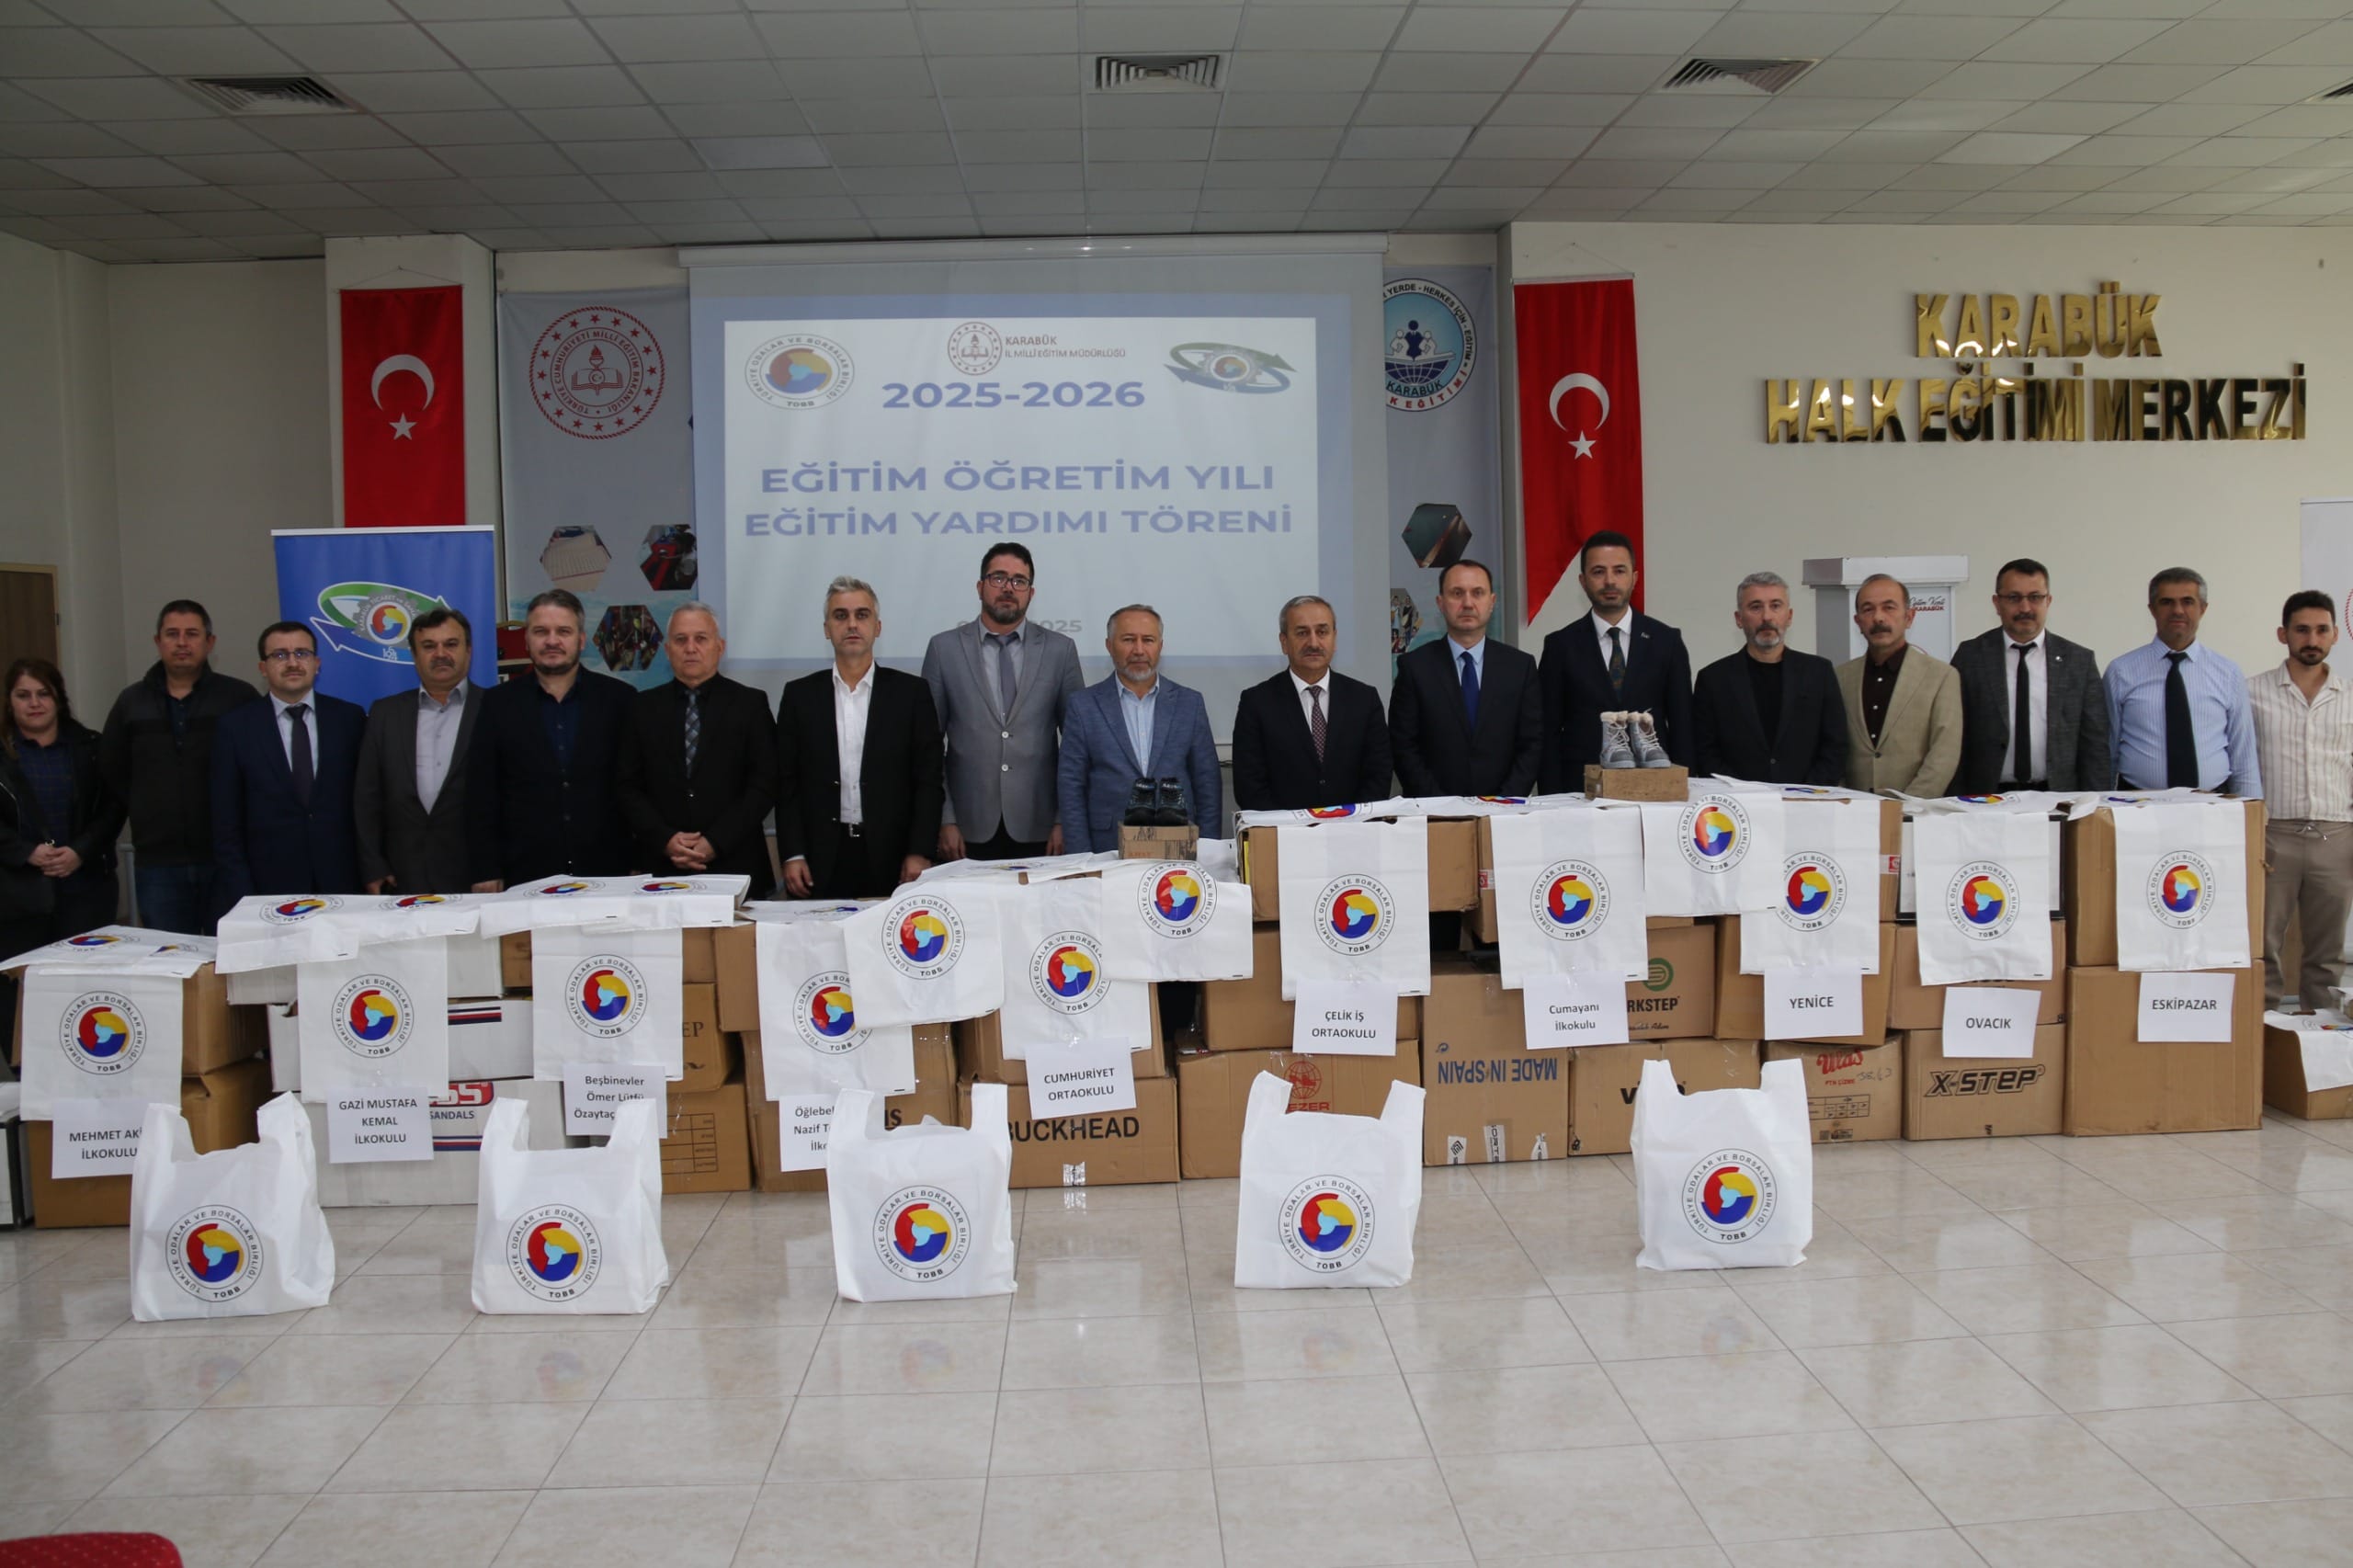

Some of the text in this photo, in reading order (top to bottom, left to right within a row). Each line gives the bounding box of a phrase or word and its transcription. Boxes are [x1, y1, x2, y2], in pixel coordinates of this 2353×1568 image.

[1387, 283, 1416, 295] YERDE
[1424, 286, 1454, 308] HERKES
[1914, 280, 2162, 358] KARABÜK
[1005, 335, 1057, 346] KARABÜK
[1386, 380, 1443, 396] KARABÜK
[882, 382, 1144, 408] 2025-2026
[1766, 362, 2306, 445] HALK EĞİTİMİ MERKEZİ
[762, 460, 1272, 493] EĞİTİM ÖĞRETİM YILI
[746, 505, 1290, 536] EĞİTİM YARDIMI TÖRENİ
[1534, 869, 1554, 899] ODALAR
[1570, 863, 1605, 892] BORSALAR
[1318, 882, 1339, 913] ODALAR
[1355, 878, 1390, 906] BORSALAR
[1801, 919, 1822, 927] TOBB
[1563, 928, 1586, 937] TOBB
[919, 965, 942, 975] TOBB
[1033, 940, 1054, 971] ODALAR
[1055, 935, 1066, 943] VE
[1070, 935, 1104, 958] BORSALA
[1095, 981, 1108, 998] LİĞİ
[569, 962, 591, 992] ODALAR
[607, 959, 642, 989] BORSALAR
[335, 983, 358, 1013] ODALAR
[373, 979, 409, 1008] BORSALAR
[1790, 994, 1834, 1009] YENİCE
[1065, 1001, 1088, 1010] TOBB
[1627, 997, 1678, 1012] RKSTEP
[2152, 996, 2217, 1010] ESKİPAZAR
[63, 999, 87, 1028] ODALAR
[88, 994, 100, 1003] VE
[104, 994, 142, 1027] BORSALAR
[1324, 1009, 1365, 1022] ÇELİK İŞ
[1549, 1004, 1599, 1016] Cumayanı
[1555, 1020, 1596, 1031] İlkokulu
[1965, 1017, 2012, 1029] OVACIK
[598, 1026, 621, 1034] TOBB
[1312, 1028, 1376, 1039] ORTAOKULU
[367, 1045, 390, 1054] TOBB
[96, 1062, 120, 1071] TOBB
[1438, 1058, 1558, 1085] MADE IN SPAIN
[585, 1075, 645, 1086] Beşbinevler
[1043, 1067, 1115, 1084] CUMHURİYET
[586, 1091, 616, 1102] Ömer
[1048, 1085, 1114, 1101] ORTAOKULU
[339, 1098, 418, 1110] GAZİ MUSTAFA
[1288, 1102, 1330, 1111] EZER
[574, 1108, 615, 1120] Özaytaç
[795, 1106, 835, 1119] Öğlebel
[361, 1117, 399, 1127] KEMAL
[793, 1123, 821, 1135] Nazif
[69, 1130, 121, 1142] MEHMET
[355, 1133, 406, 1144] İLKOKULU
[81, 1148, 138, 1160] İLKOKULU
[1715, 1153, 1728, 1161] VE
[1687, 1157, 1712, 1192] ODALAR
[1733, 1153, 1771, 1188] BORSALAR
[1314, 1179, 1326, 1187] VE
[903, 1190, 915, 1199] VE
[1284, 1183, 1312, 1217] ODALAR
[1331, 1180, 1370, 1218] BORSALAR
[920, 1189, 964, 1223] BORSALAR
[193, 1210, 206, 1220] VE
[538, 1209, 550, 1218] VE
[878, 1197, 902, 1231] ODALAR
[1686, 1197, 1710, 1233] TÜRKİYE
[210, 1210, 256, 1240] BORSALAR
[554, 1209, 596, 1244] BORSALAR
[170, 1218, 191, 1255] ODALAR
[511, 1215, 535, 1249] ODALAR
[1719, 1230, 1746, 1240] TOBB
[1284, 1221, 1306, 1259] TÜRKİYE
[878, 1236, 904, 1273] TÜRKİYE
[1314, 1258, 1341, 1267] TOBB
[171, 1259, 200, 1294] TÜRKİYE
[511, 1254, 537, 1291] TÜRKİYE
[916, 1267, 943, 1278] TOBB
[213, 1284, 240, 1297] TOBB
[548, 1286, 574, 1297] TOBB
